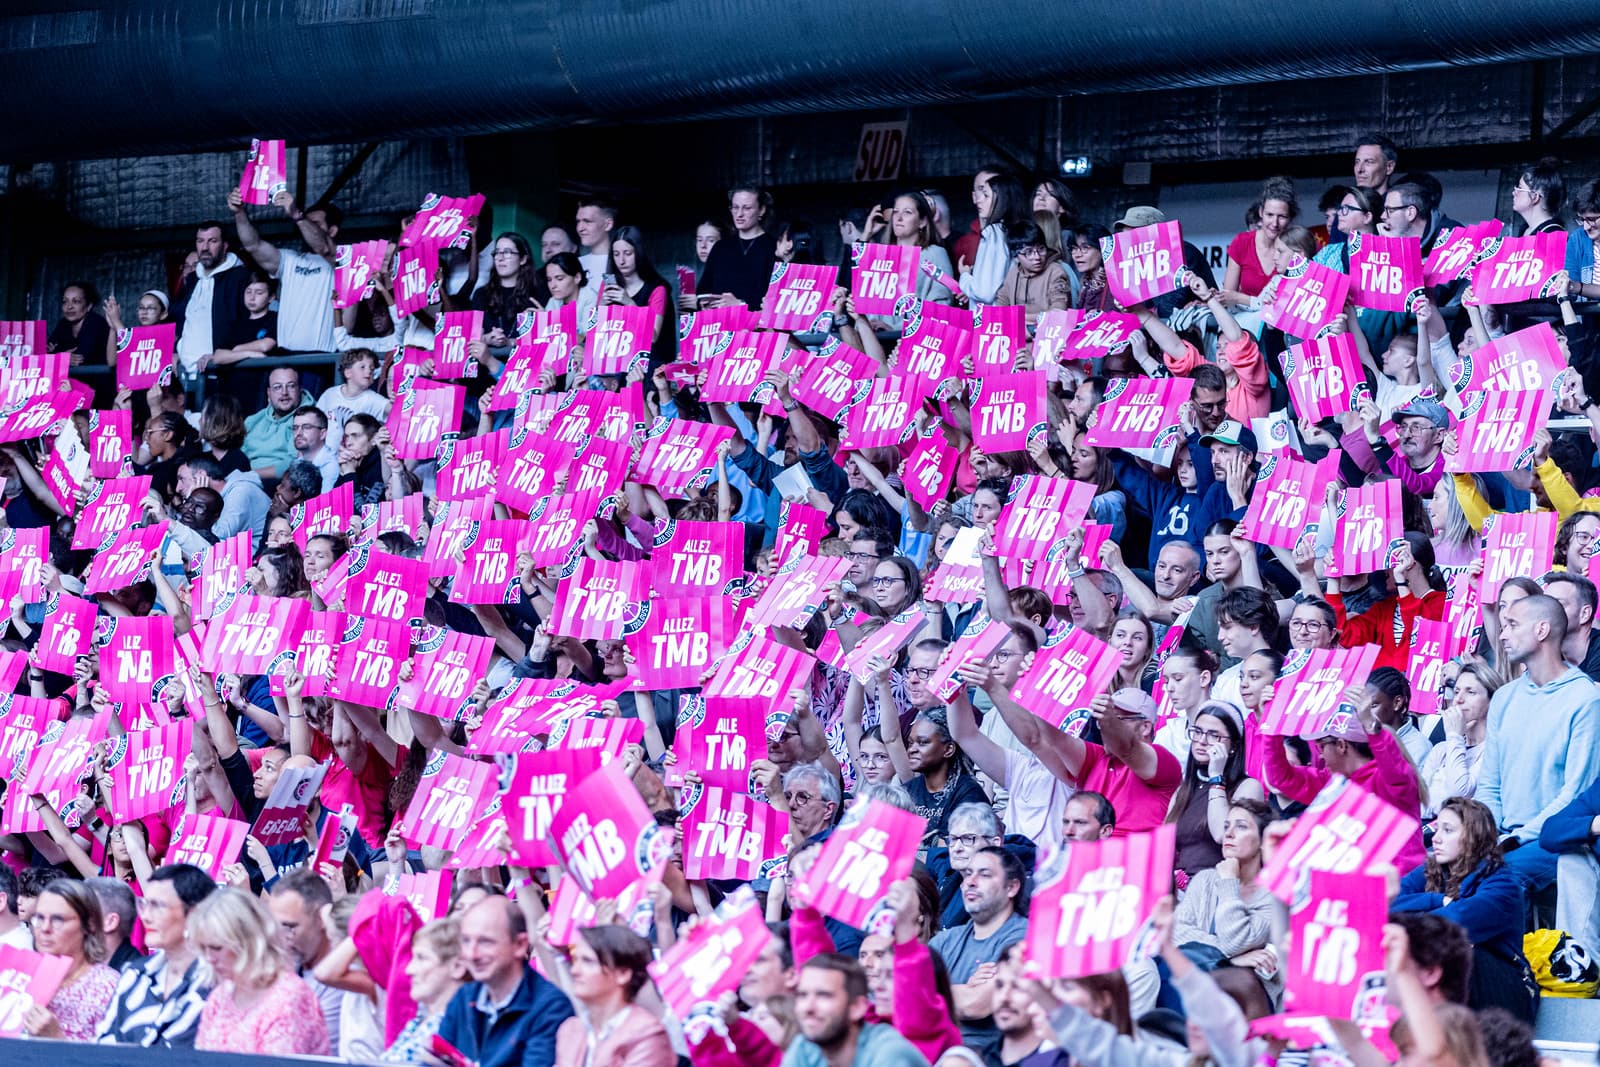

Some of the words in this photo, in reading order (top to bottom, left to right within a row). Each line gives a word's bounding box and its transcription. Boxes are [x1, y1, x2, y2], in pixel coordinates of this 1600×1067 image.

[856, 129, 900, 181] SUD
[1127, 241, 1155, 258] ALLEZ
[870, 260, 892, 272] ALLEZ
[1119, 250, 1169, 289] TMB
[1360, 263, 1402, 294] TMB
[1490, 259, 1543, 288] TMB
[790, 279, 816, 289] ALLEZ
[860, 272, 898, 299] TMB
[774, 289, 823, 316] TMB
[1286, 288, 1327, 324] TMB
[137, 339, 156, 350] ALLEZ
[593, 332, 633, 358] TMB
[693, 337, 718, 362] TM
[734, 347, 757, 358] ALLEZ
[921, 335, 942, 349] ALLEZ
[130, 350, 160, 376] TMB
[718, 358, 761, 386] TMB
[907, 346, 946, 380] TMB
[1459, 358, 1471, 388] TOULOUSE
[1488, 351, 1518, 376] ALLEZ
[8, 377, 49, 399] TMB
[811, 366, 850, 403] TMB
[876, 392, 902, 404] ALLEZ
[989, 390, 1015, 403] ALLEZ
[1299, 365, 1343, 402] TMB
[1129, 393, 1158, 405] ALLEZ
[604, 410, 629, 440] MB
[862, 402, 908, 432] TMB
[981, 403, 1026, 435] TMB
[1112, 405, 1164, 432] TMB
[670, 435, 699, 447] ALLEZ
[1472, 422, 1524, 452] TMB
[461, 451, 483, 465] ALLEZ
[524, 449, 544, 465] ALLEZ
[652, 444, 703, 472] TMB
[506, 458, 546, 495] TMB
[92, 504, 131, 533] TMB
[1259, 490, 1304, 528] TMB
[533, 521, 576, 553] TMB
[1009, 507, 1061, 541] TMB
[435, 531, 465, 558] TM
[483, 539, 501, 552] ALLEZ
[682, 540, 710, 552] ALLEZ
[374, 570, 402, 586] ALLEZ
[474, 552, 508, 585] TMB
[671, 553, 722, 586] TMB
[585, 577, 617, 591] ALLEZ
[362, 583, 408, 620] TMB
[567, 588, 628, 621] TMB
[238, 613, 269, 626] ALLEZ
[662, 618, 695, 634] ALLEZ
[219, 625, 278, 656] TMB
[652, 632, 708, 668] TMB
[351, 651, 393, 687] TMB
[747, 658, 776, 673] ALLEZ
[425, 663, 470, 699] TMB
[722, 667, 779, 696] TMB
[1035, 659, 1087, 706] TMB
[1285, 680, 1344, 716] TMB
[128, 758, 174, 799] TMB
[519, 797, 562, 840] TM
[712, 807, 747, 827] ALLEZ
[570, 819, 625, 891] MB
[695, 822, 761, 861] TMB
